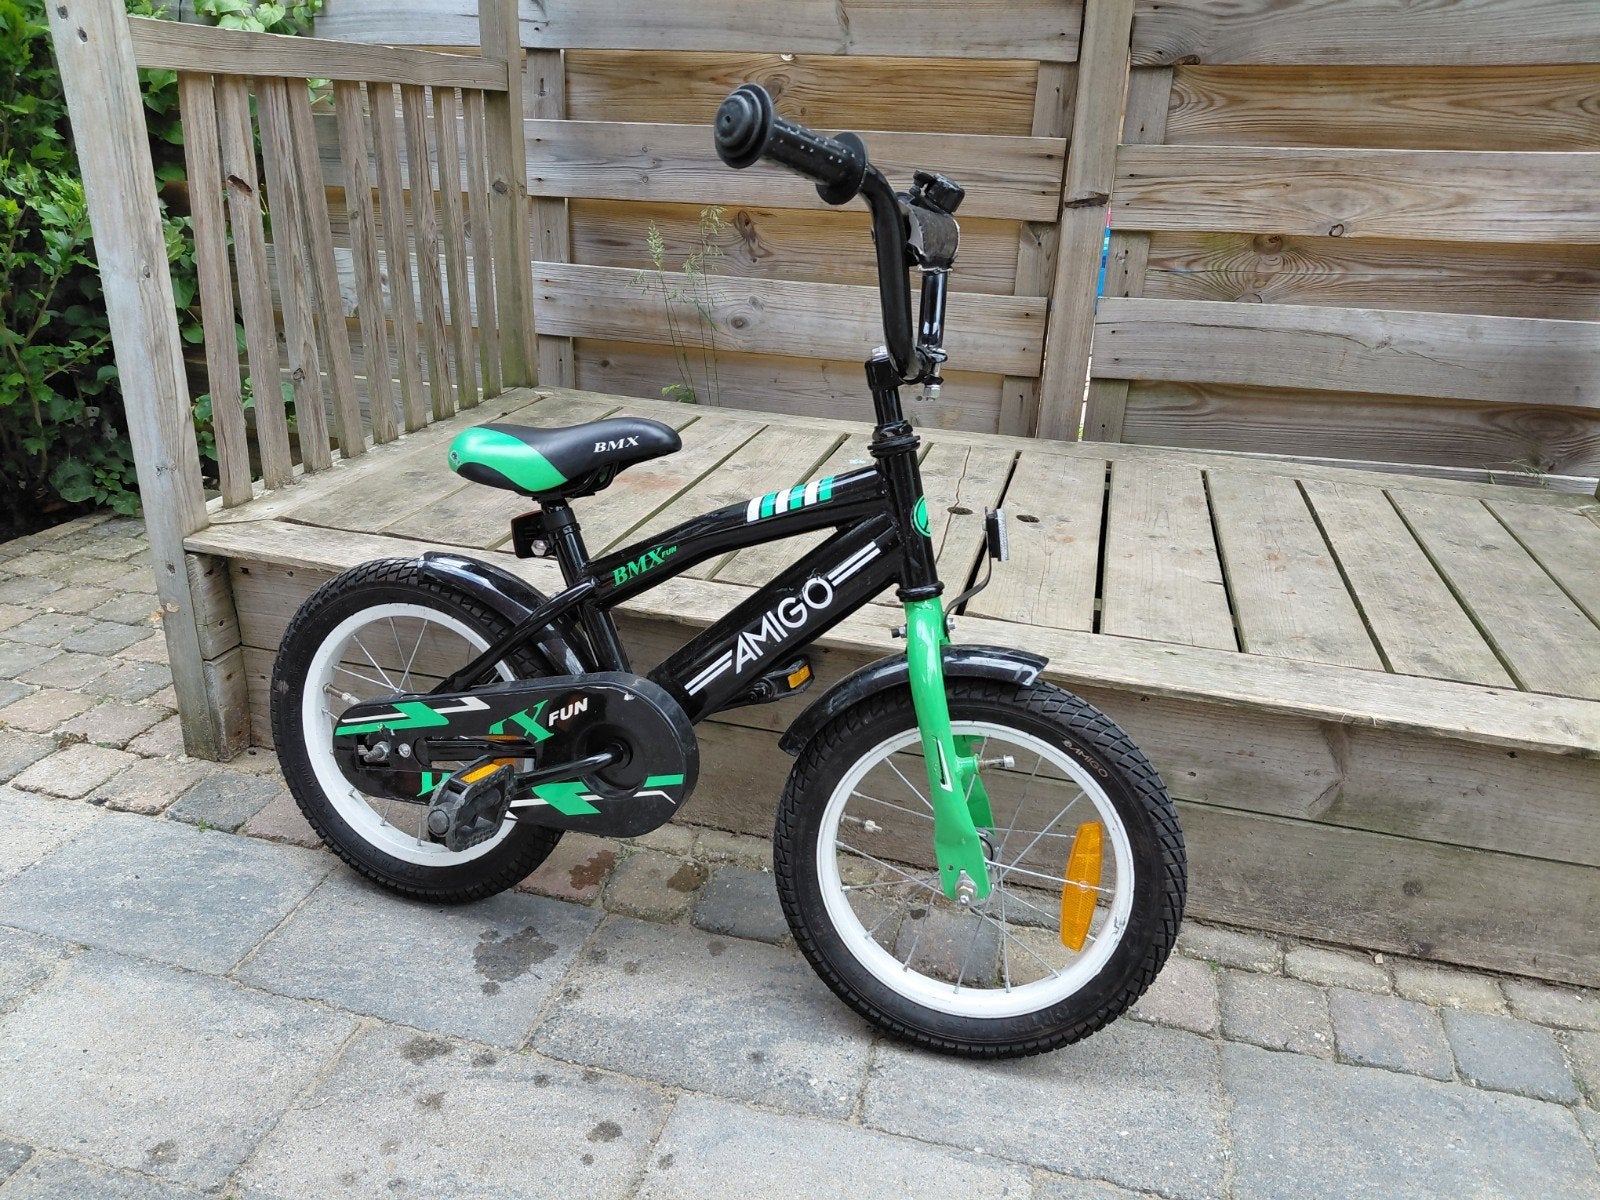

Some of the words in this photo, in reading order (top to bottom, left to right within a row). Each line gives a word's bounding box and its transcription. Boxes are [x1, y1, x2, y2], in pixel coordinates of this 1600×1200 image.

[593, 435, 639, 453] BMX
[612, 545, 666, 587] BMX
[661, 545, 678, 558] FUN
[735, 575, 834, 675] AMIGO
[548, 697, 588, 727] FUN
[1070, 746, 1109, 778] AMIGO
